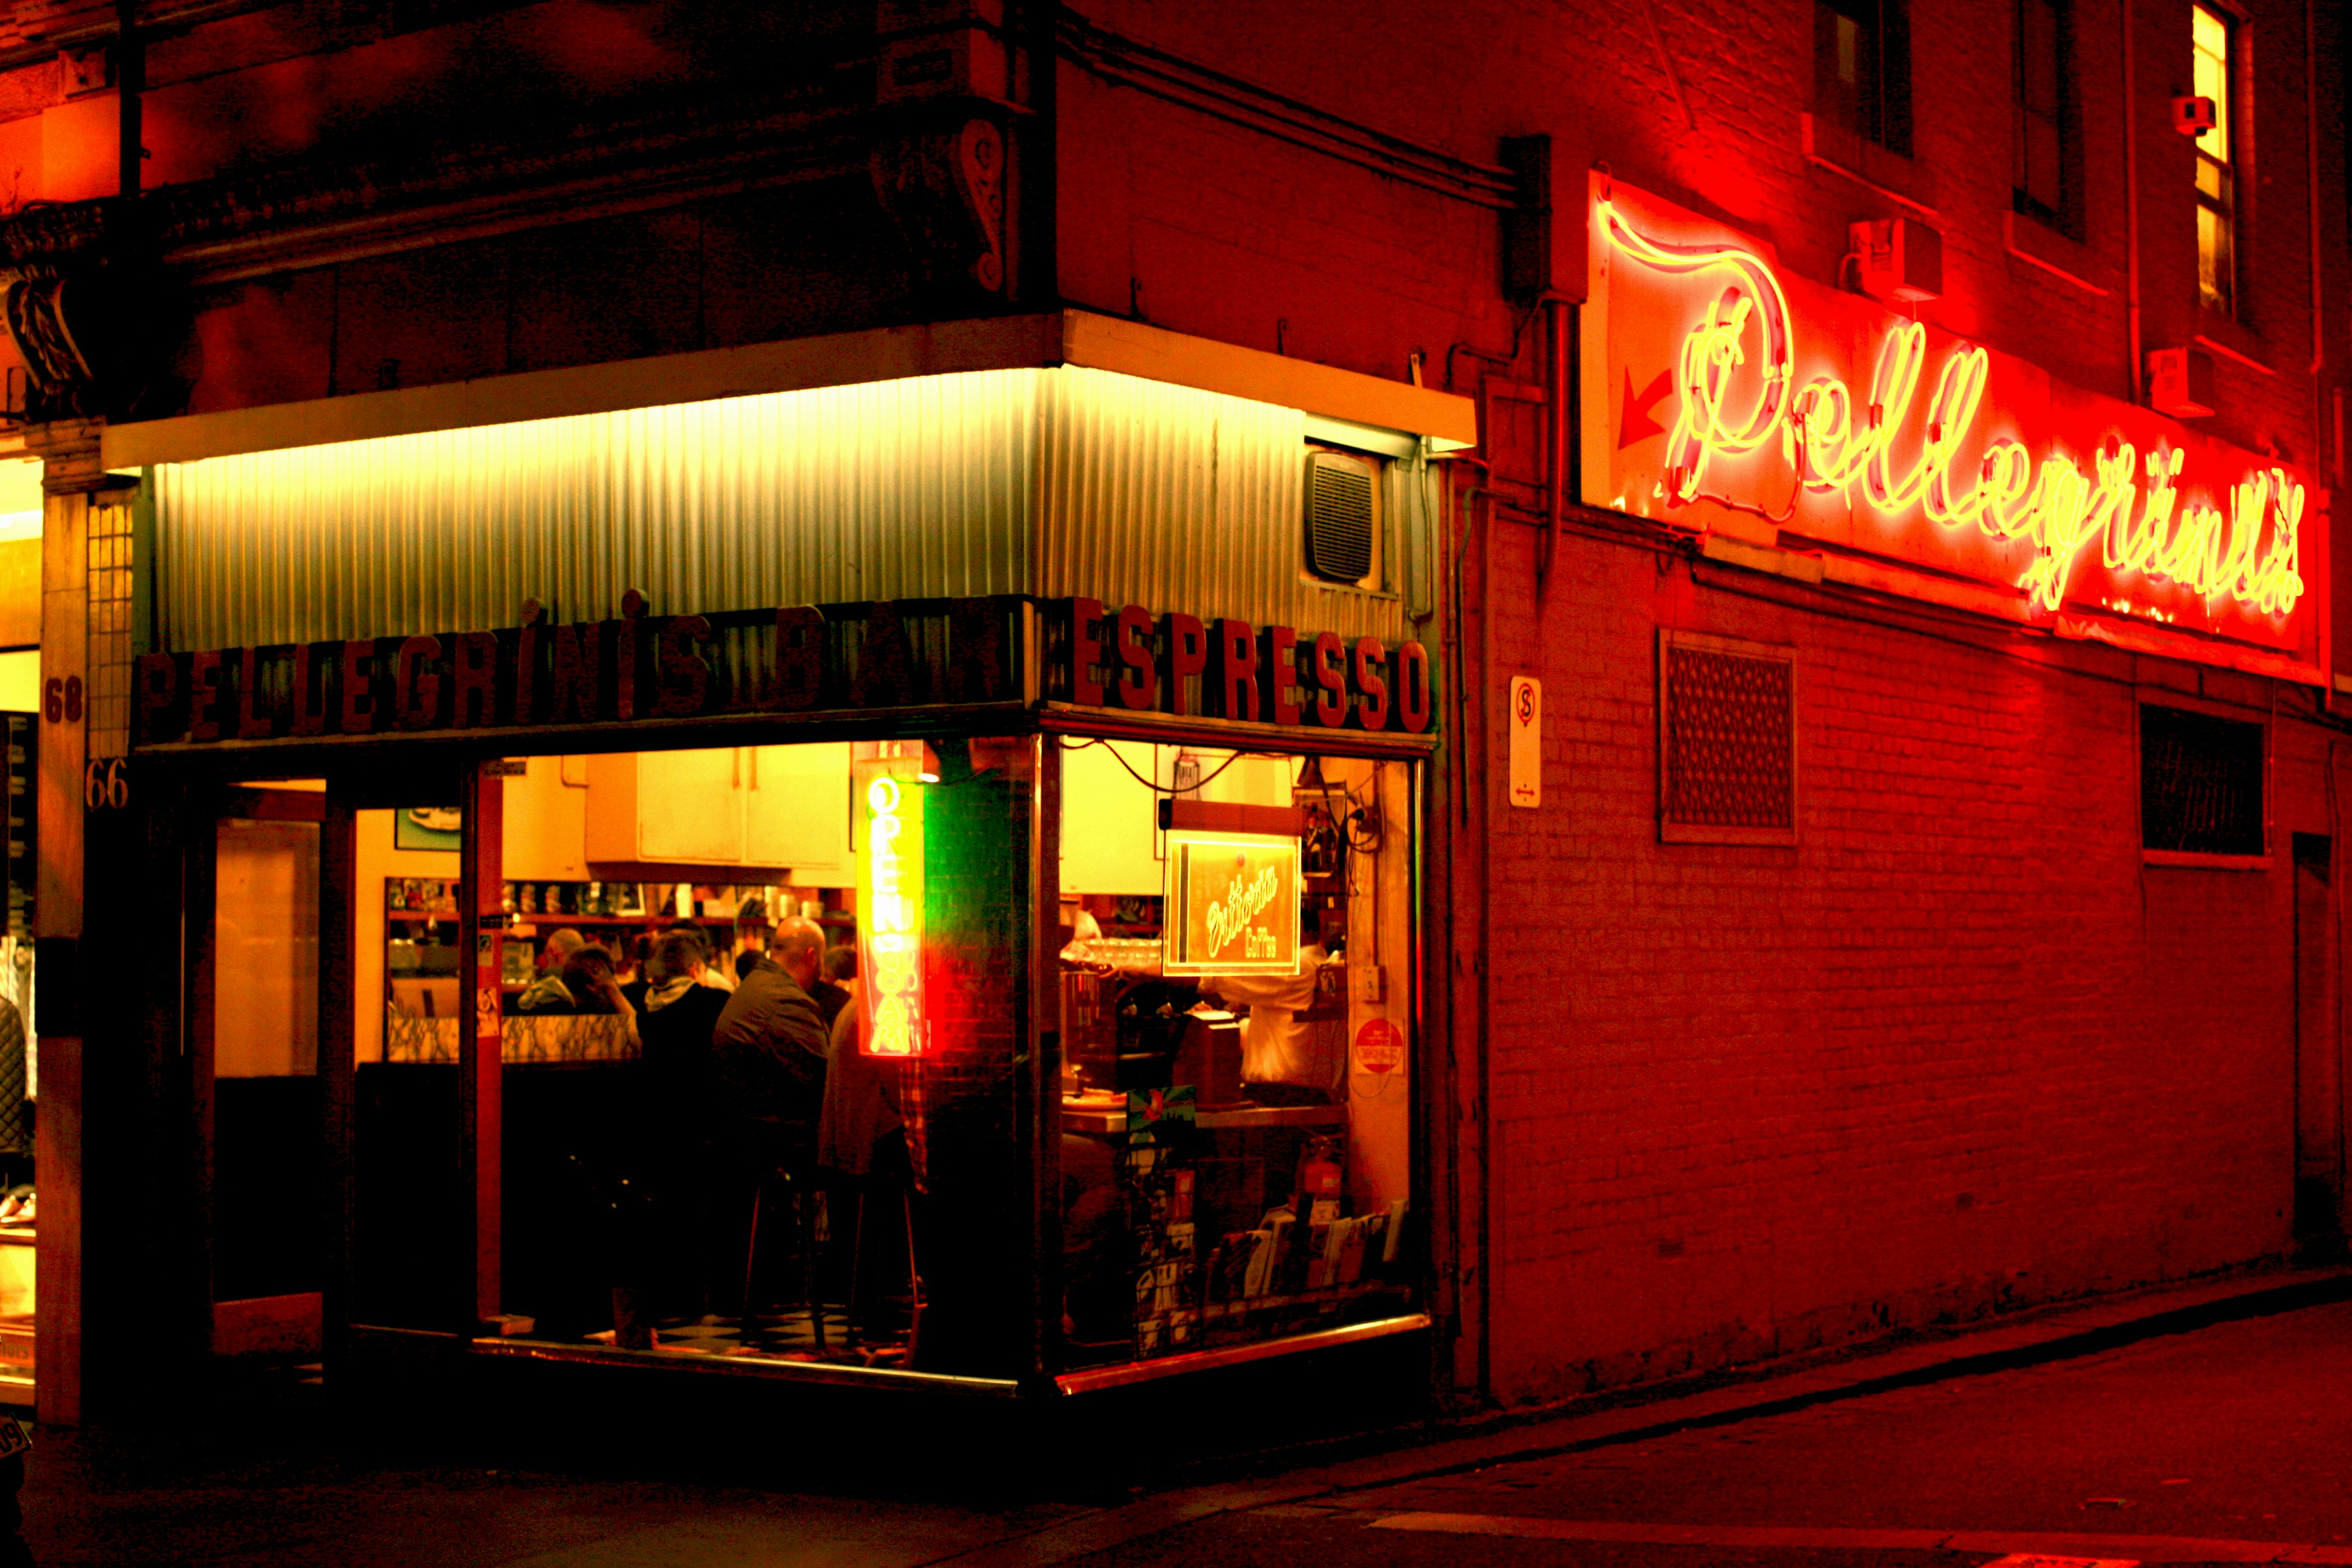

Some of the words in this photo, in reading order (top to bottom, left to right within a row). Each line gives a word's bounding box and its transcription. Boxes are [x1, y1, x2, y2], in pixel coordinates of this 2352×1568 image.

[777, 596, 1002, 711] BAR
[1070, 597, 1429, 733] ESPRESSO
[45, 676, 82, 723] 68
[86, 758, 128, 809] 66
[1245, 926, 1277, 958] Coffee
